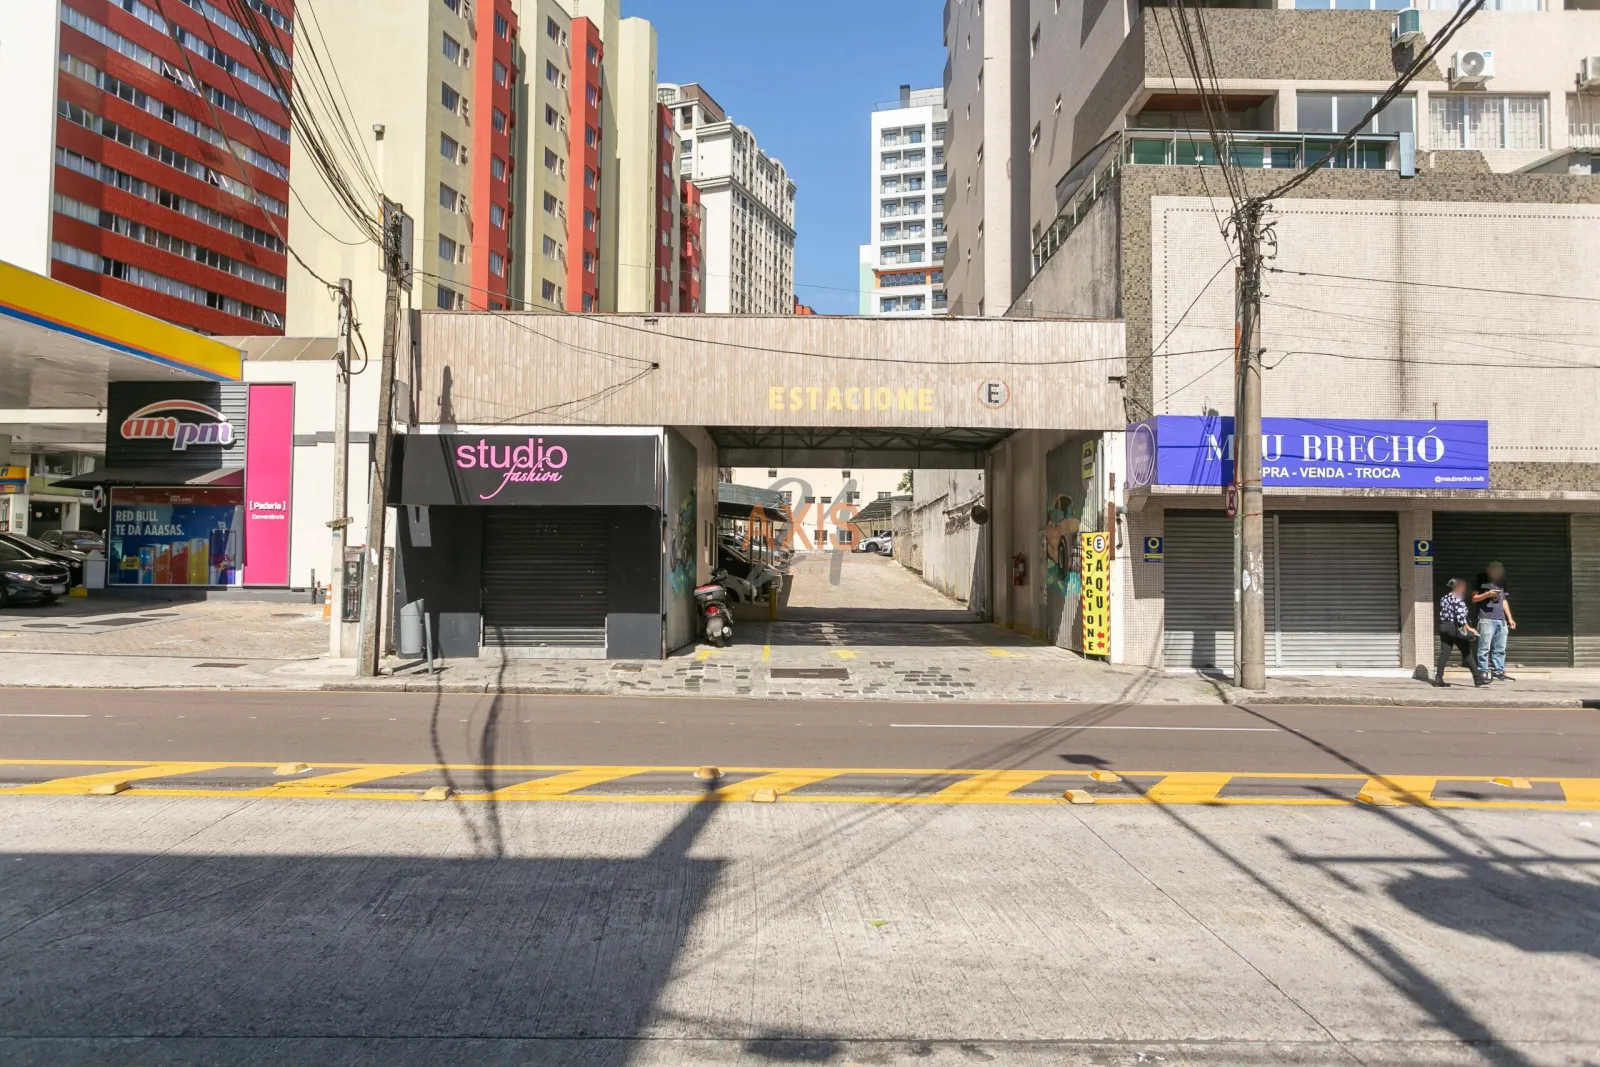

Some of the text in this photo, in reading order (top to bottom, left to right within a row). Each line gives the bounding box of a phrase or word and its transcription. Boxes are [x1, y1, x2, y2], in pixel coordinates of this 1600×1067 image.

[767, 386, 935, 412] ESTACIONE
[987, 383, 1000, 404] E
[456, 438, 568, 469] studio
[1204, 426, 1445, 463] MU BRECHÓ
[479, 456, 563, 500] fashion
[1299, 467, 1345, 479] VENDA
[1355, 467, 1401, 479] TROCA
[115, 510, 159, 522] RED BULL
[115, 522, 185, 536] TE DÁ AAASAS.
[1085, 537, 1095, 651] ESTACIONE
[1095, 559, 1104, 627] AQUI
